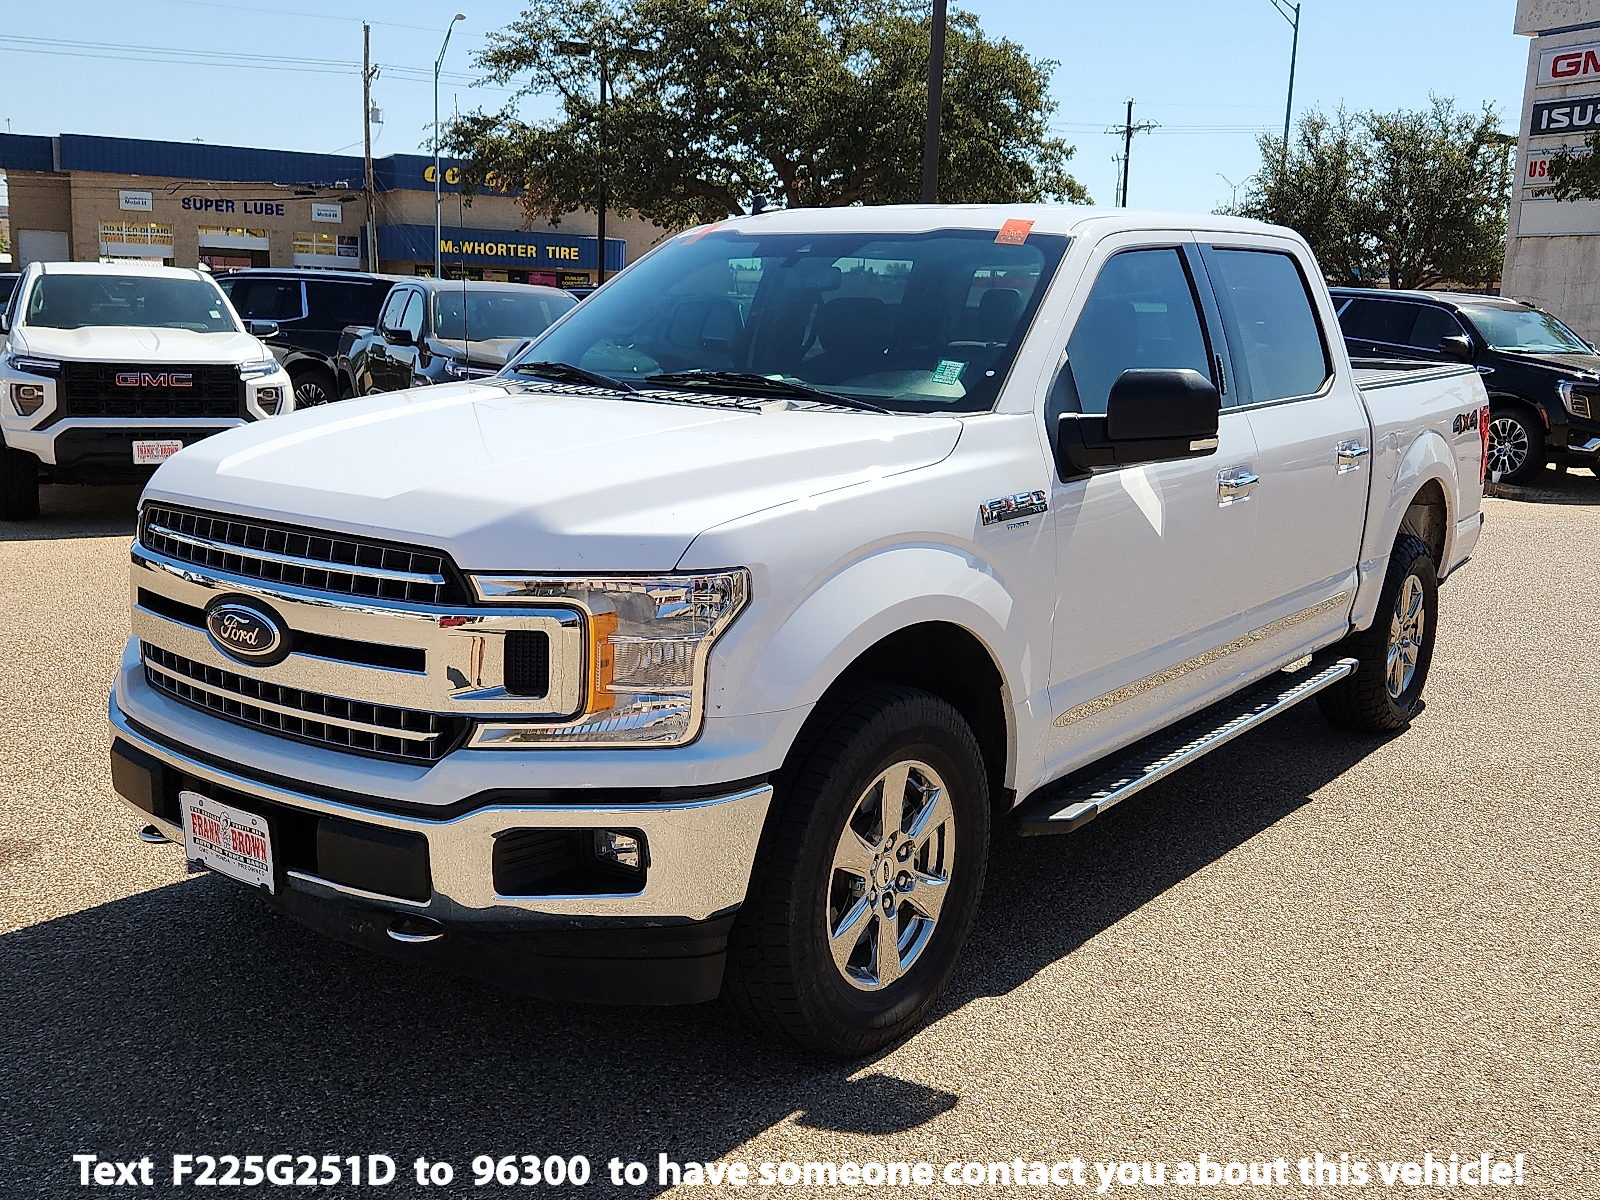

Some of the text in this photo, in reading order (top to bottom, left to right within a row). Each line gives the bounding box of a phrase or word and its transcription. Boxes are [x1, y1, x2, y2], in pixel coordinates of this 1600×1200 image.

[181, 197, 285, 216] SUPER LUBE
[440, 240, 579, 260] McWHORTER TIRE
[115, 372, 193, 387] GMC
[1032, 504, 1047, 512] XLT
[220, 613, 260, 646] Ford
[191, 813, 267, 862] FRANK BROWN
[195, 837, 211, 849] AUTO
[224, 848, 245, 861] TRUCK
[246, 856, 268, 872] RANCH
